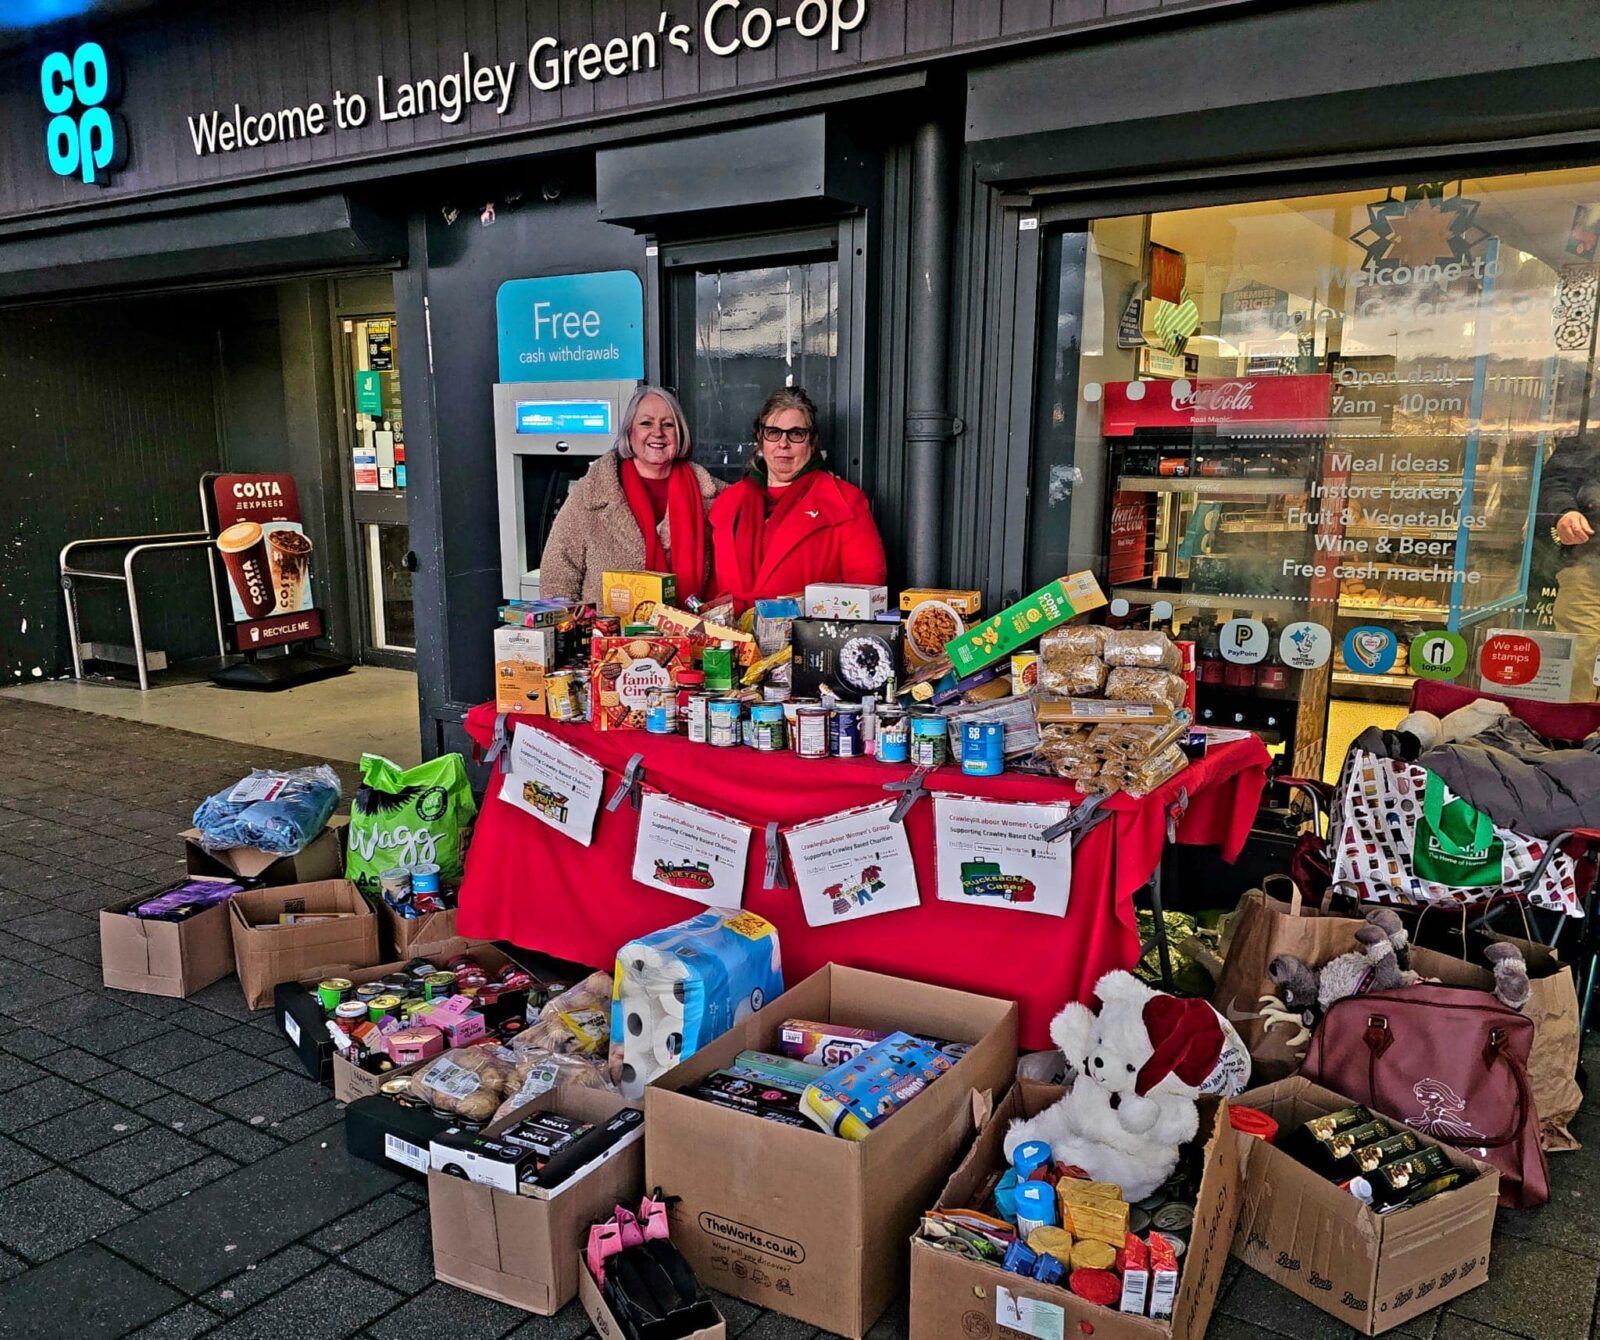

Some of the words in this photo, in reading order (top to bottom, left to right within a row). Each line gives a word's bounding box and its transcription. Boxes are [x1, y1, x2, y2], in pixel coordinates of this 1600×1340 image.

[188, 102, 325, 155] Welcome
[333, 90, 367, 129] to
[378, 51, 515, 124] Langley
[527, 11, 690, 91] Green's
[704, 0, 866, 57] Co-op
[1317, 255, 1462, 289] Welcome
[1472, 256, 1505, 280] to
[534, 302, 600, 340] Free
[520, 347, 545, 364] cash
[549, 343, 620, 363] withdrawals
[1338, 367, 1401, 389] Open
[1407, 364, 1460, 391] daily
[1332, 396, 1376, 414] 7am
[1400, 394, 1462, 419] 10pm
[1331, 453, 1383, 473] Meal
[1390, 453, 1450, 473] ideas
[233, 481, 282, 498] COSTA
[1310, 481, 1383, 500] Instore
[1390, 481, 1468, 505] bakery
[243, 499, 285, 510] EXPRESS
[1287, 507, 1337, 527] Fruit
[1340, 509, 1359, 527] &
[1363, 508, 1487, 532] Vegetables
[1314, 534, 1369, 553] Wine
[1375, 536, 1393, 554] &
[1400, 537, 1452, 555] Beer
[1282, 559, 1327, 577] Free
[1333, 561, 1380, 579] cash
[1387, 563, 1481, 583] machine
[243, 560, 263, 605] COSTA
[1044, 592, 1061, 618] CORN
[263, 623, 297, 638] RECYCLE
[298, 621, 310, 631] ME
[1228, 649, 1258, 658] PayPoint
[1493, 641, 1510, 650] We
[1513, 640, 1531, 651] sell
[1491, 652, 1530, 663] stamps
[1421, 663, 1452, 673] top-up
[622, 671, 666, 687] family
[886, 734, 907, 744] RICE
[950, 827, 982, 836] Supporting
[982, 830, 1007, 839] Crawley
[1001, 820, 1033, 829] Women's
[349, 821, 448, 869] Wagg
[803, 850, 832, 861] Supporting
[655, 871, 715, 887] TOILETRIES
[963, 875, 1027, 888] Rucksacks
[987, 884, 1024, 892] Cases
[898, 1077, 926, 1101] JUMBO
[539, 1118, 570, 1130] LYNX
[519, 1131, 549, 1143] LYNX
[706, 1217, 798, 1258] TheWorks.co.uk
[712, 1240, 730, 1252] What
[732, 1247, 743, 1256] will
[744, 1253, 757, 1265] you
[757, 1257, 792, 1272] discover?
[1276, 1251, 1301, 1271] Boots
[1307, 1270, 1333, 1291] Boots
[1341, 1291, 1368, 1311] Boots
